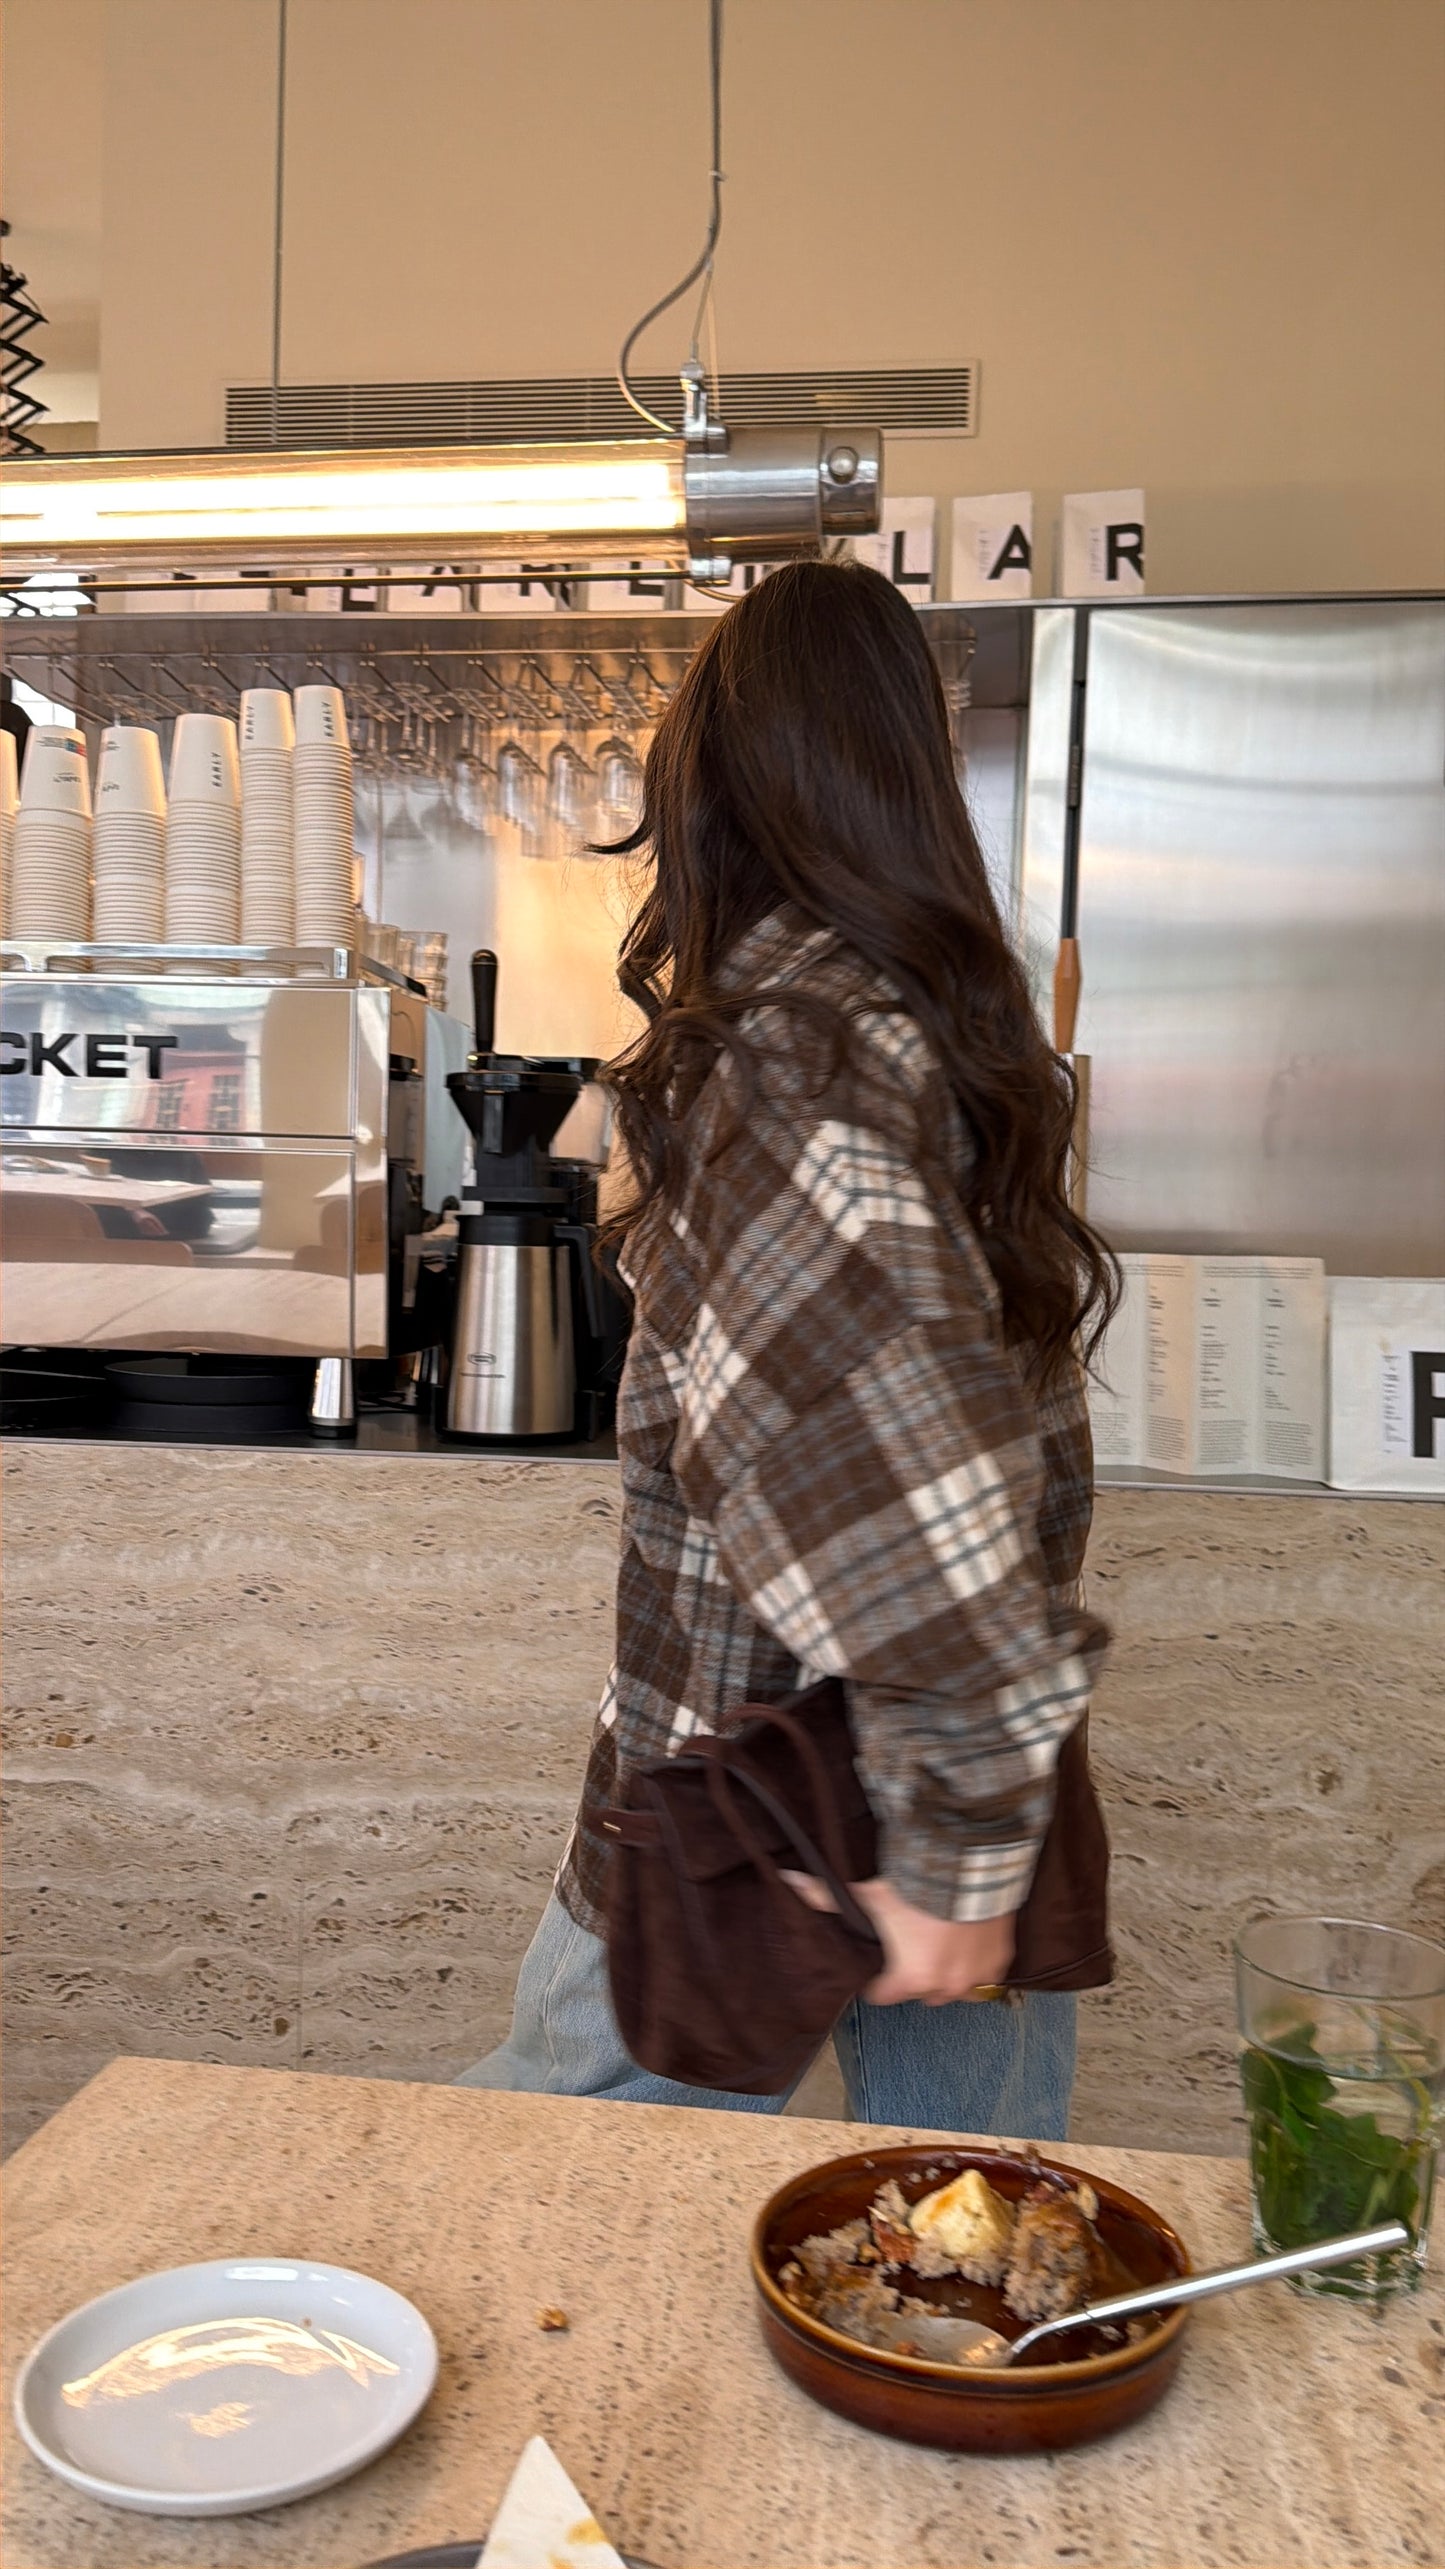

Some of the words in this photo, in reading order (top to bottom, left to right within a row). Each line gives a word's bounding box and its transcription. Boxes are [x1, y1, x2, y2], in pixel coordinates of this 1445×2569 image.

[892, 530, 930, 585] L
[987, 524, 1031, 580] A
[1105, 523, 1144, 582] R
